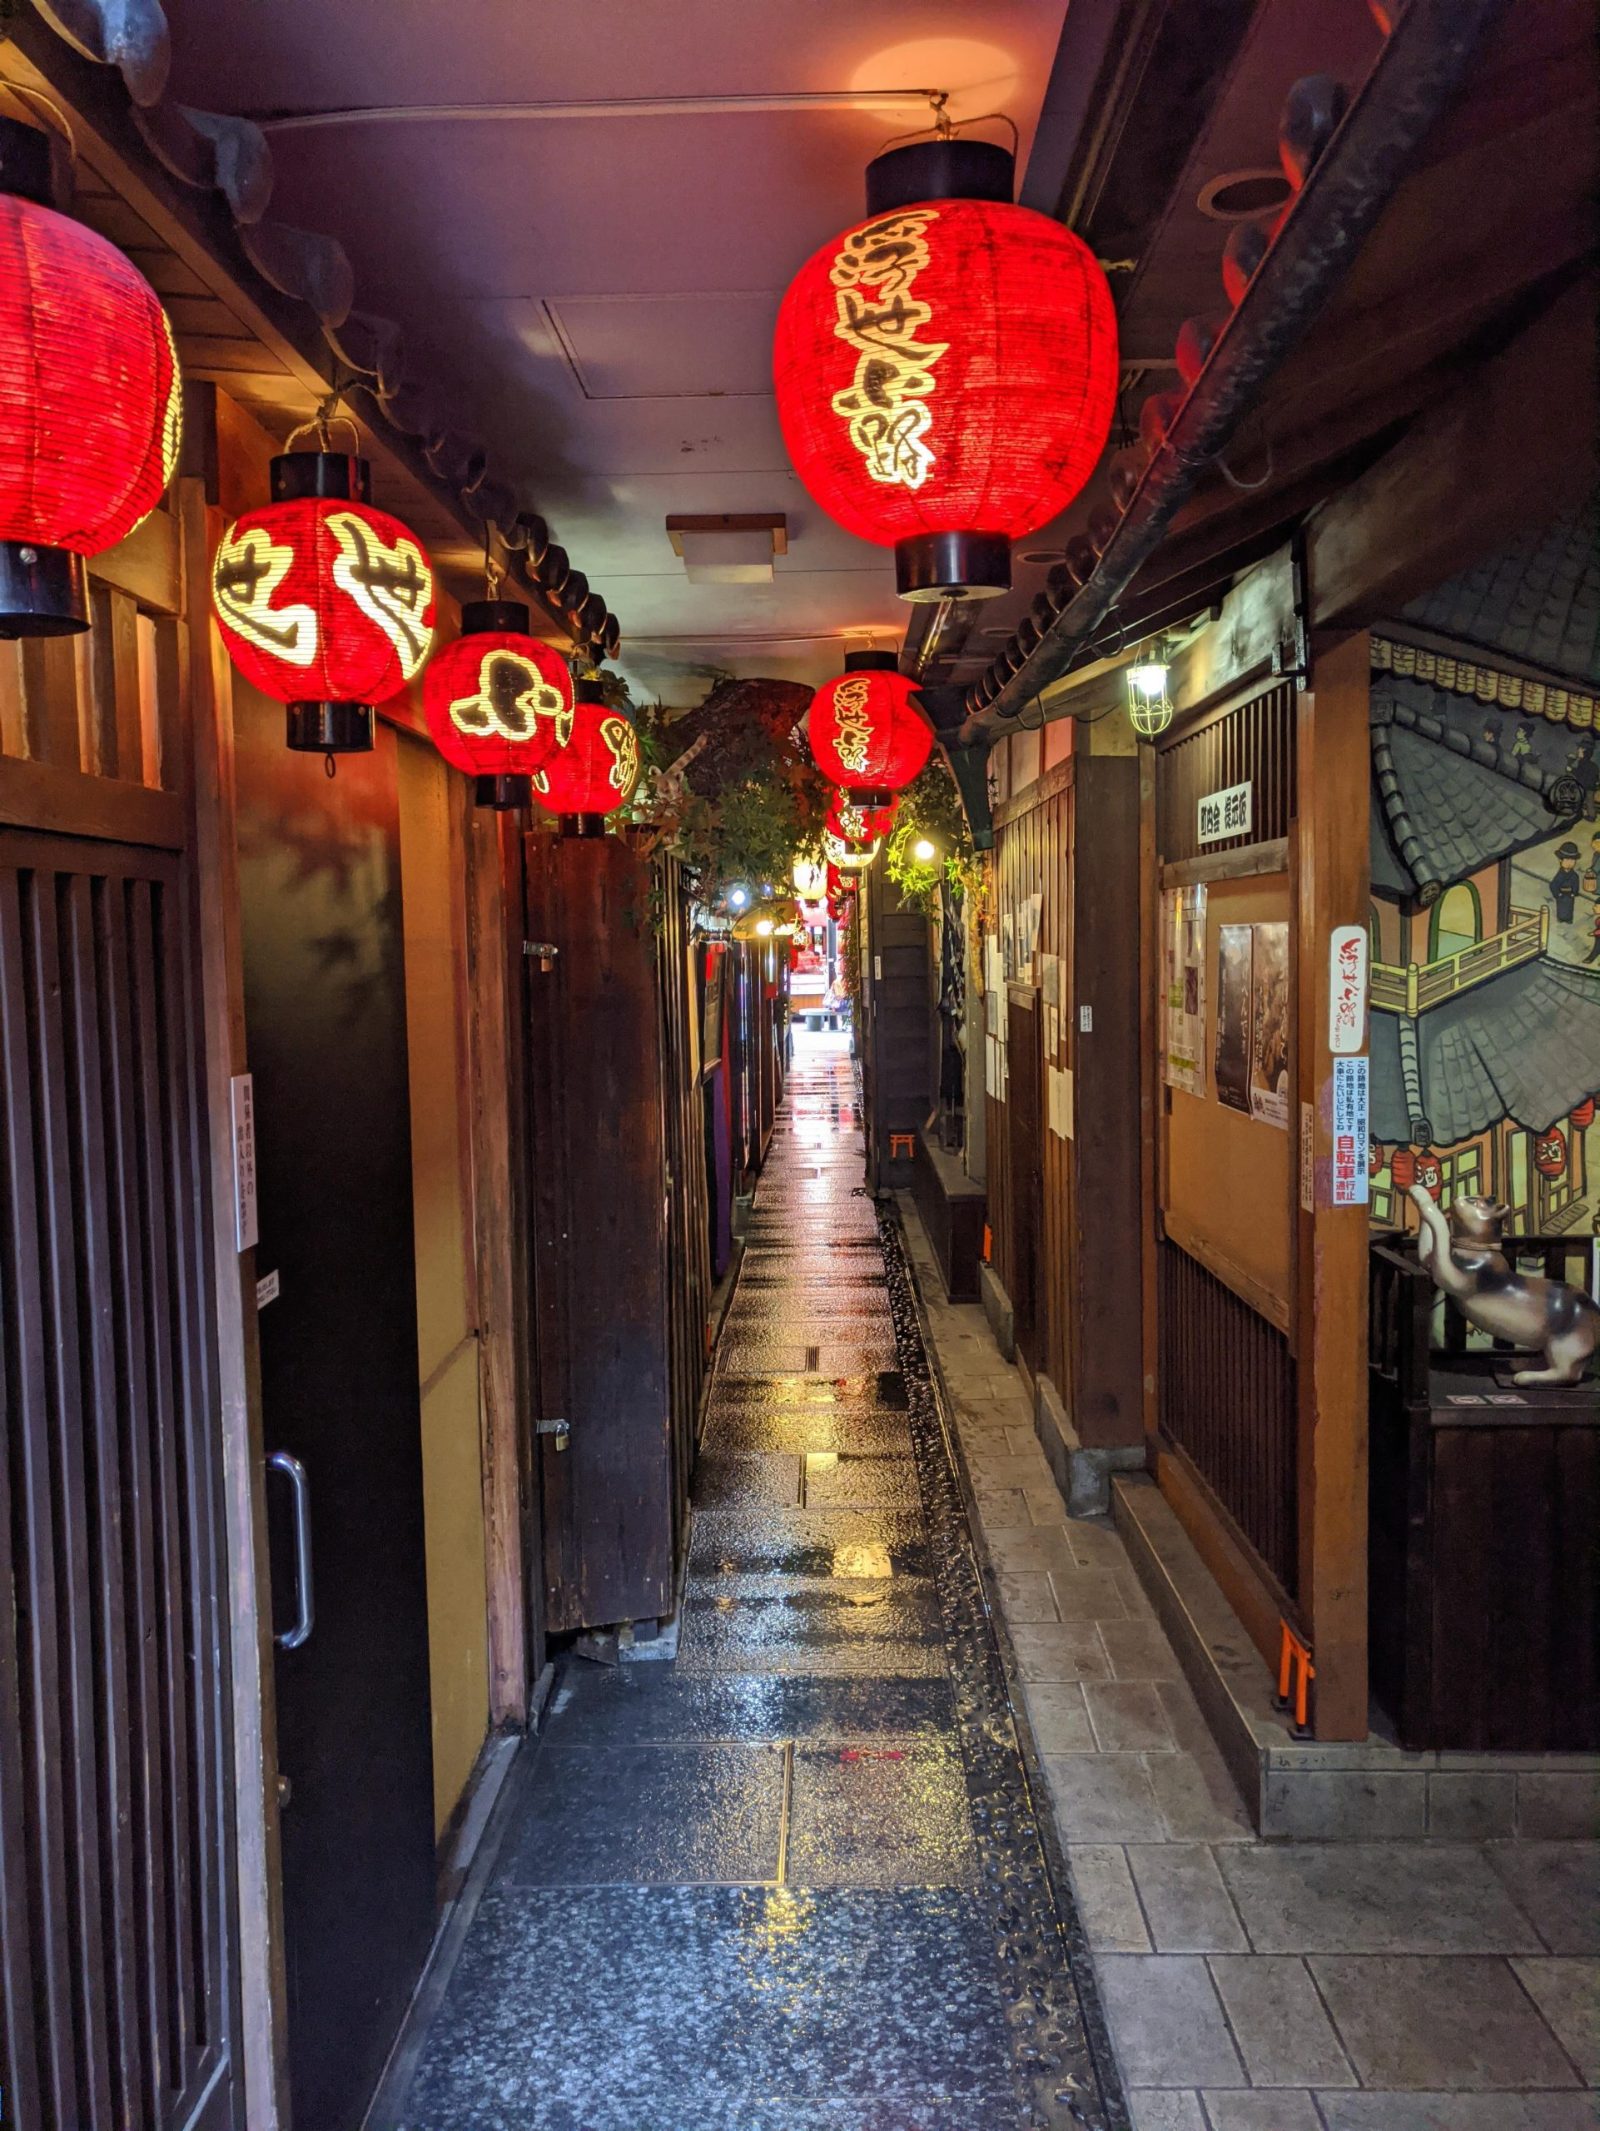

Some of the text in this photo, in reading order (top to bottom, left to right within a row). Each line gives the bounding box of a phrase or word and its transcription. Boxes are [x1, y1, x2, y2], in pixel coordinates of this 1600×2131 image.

[1201, 801, 1221, 836] 町内会
[1345, 1060, 1355, 1131] この路地は私有地です
[1336, 1135, 1355, 1180] 自転車
